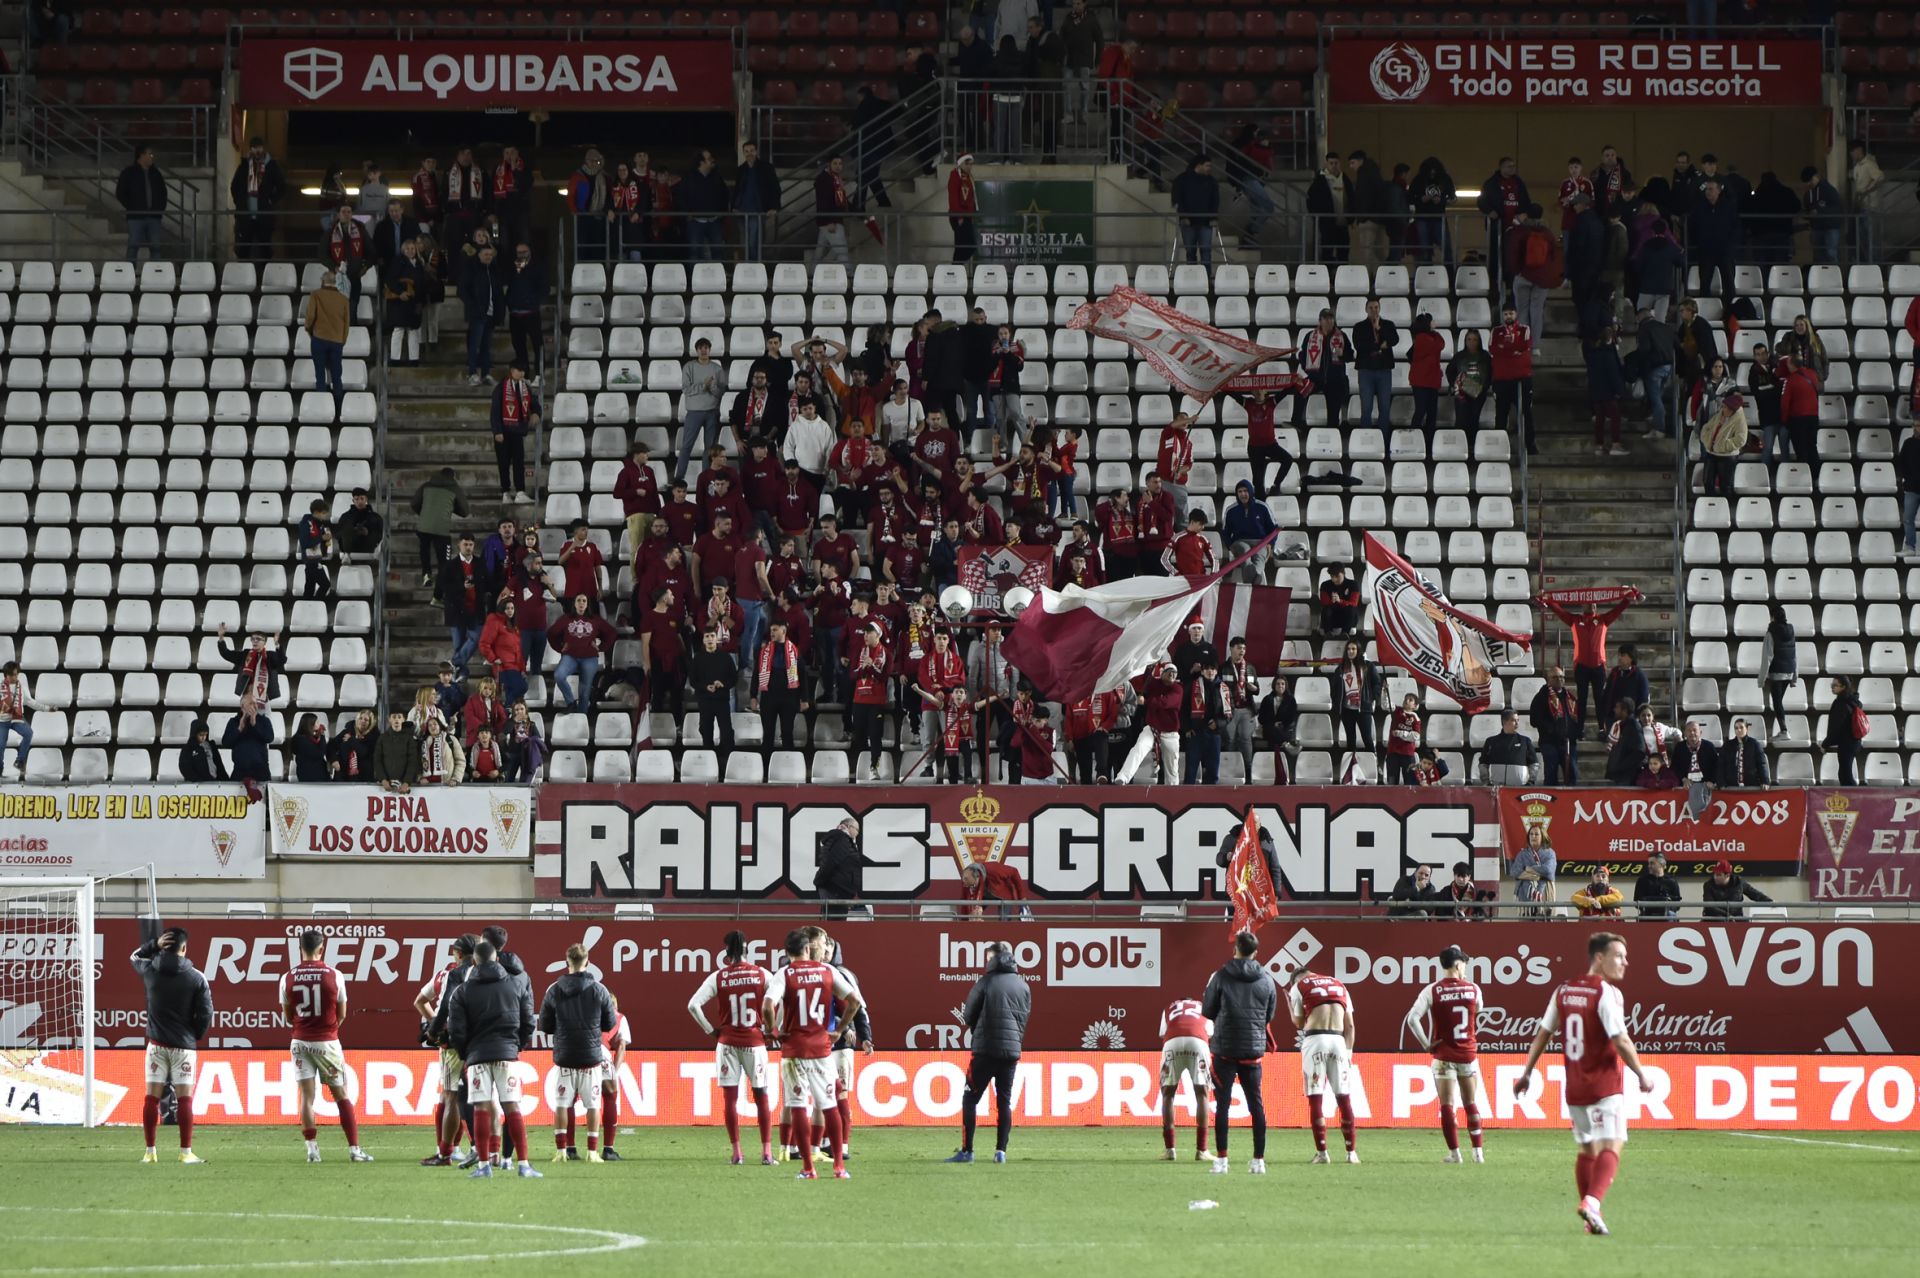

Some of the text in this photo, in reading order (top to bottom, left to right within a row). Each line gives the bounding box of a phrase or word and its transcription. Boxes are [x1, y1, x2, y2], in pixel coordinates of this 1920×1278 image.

[1435, 44, 1782, 71] GINES ROSELL
[361, 53, 679, 98] ALQUIBARSA
[1450, 72, 1762, 102] todo para su mascota
[980, 232, 1087, 247] ESTRELLA
[67, 793, 100, 819] LUZ
[104, 795, 127, 819] EN
[131, 795, 152, 819] LA
[157, 795, 248, 819] OSCURIDAD
[1573, 799, 1790, 826] MURCIA 2008
[308, 824, 488, 854] LOS COLORAOS
[1029, 803, 1475, 898] GRANAS
[1608, 838, 1746, 853] #ElDeTodaLaVida
[6, 855, 73, 865] COLORADOS
[1560, 861, 1644, 874] Funada
[1693, 863, 1745, 874] 206
[1815, 867, 1912, 898] REAL
[612, 938, 785, 973] PrimFr
[1055, 935, 1147, 981] polt
[1334, 944, 1552, 985] Domno's
[1657, 926, 1874, 987] svan
[294, 973, 322, 982] KADETE
[292, 985, 322, 1017] 21
[728, 992, 757, 1028] 16
[797, 988, 825, 1026] 14
[1108, 1005, 1126, 1021] bp
[1168, 1000, 1202, 1021] 22
[77, 1009, 148, 1028] RUPOS
[1452, 1006, 1469, 1039] 2
[1624, 1002, 1733, 1037] Murcia
[1476, 1040, 1563, 1051] restaurte
[1565, 1013, 1585, 1062] 8
[192, 1060, 452, 1117] AHORA
[1392, 1064, 1674, 1120] PARTR
[1695, 1065, 1798, 1120] DE
[1818, 1065, 1920, 1122] 70
